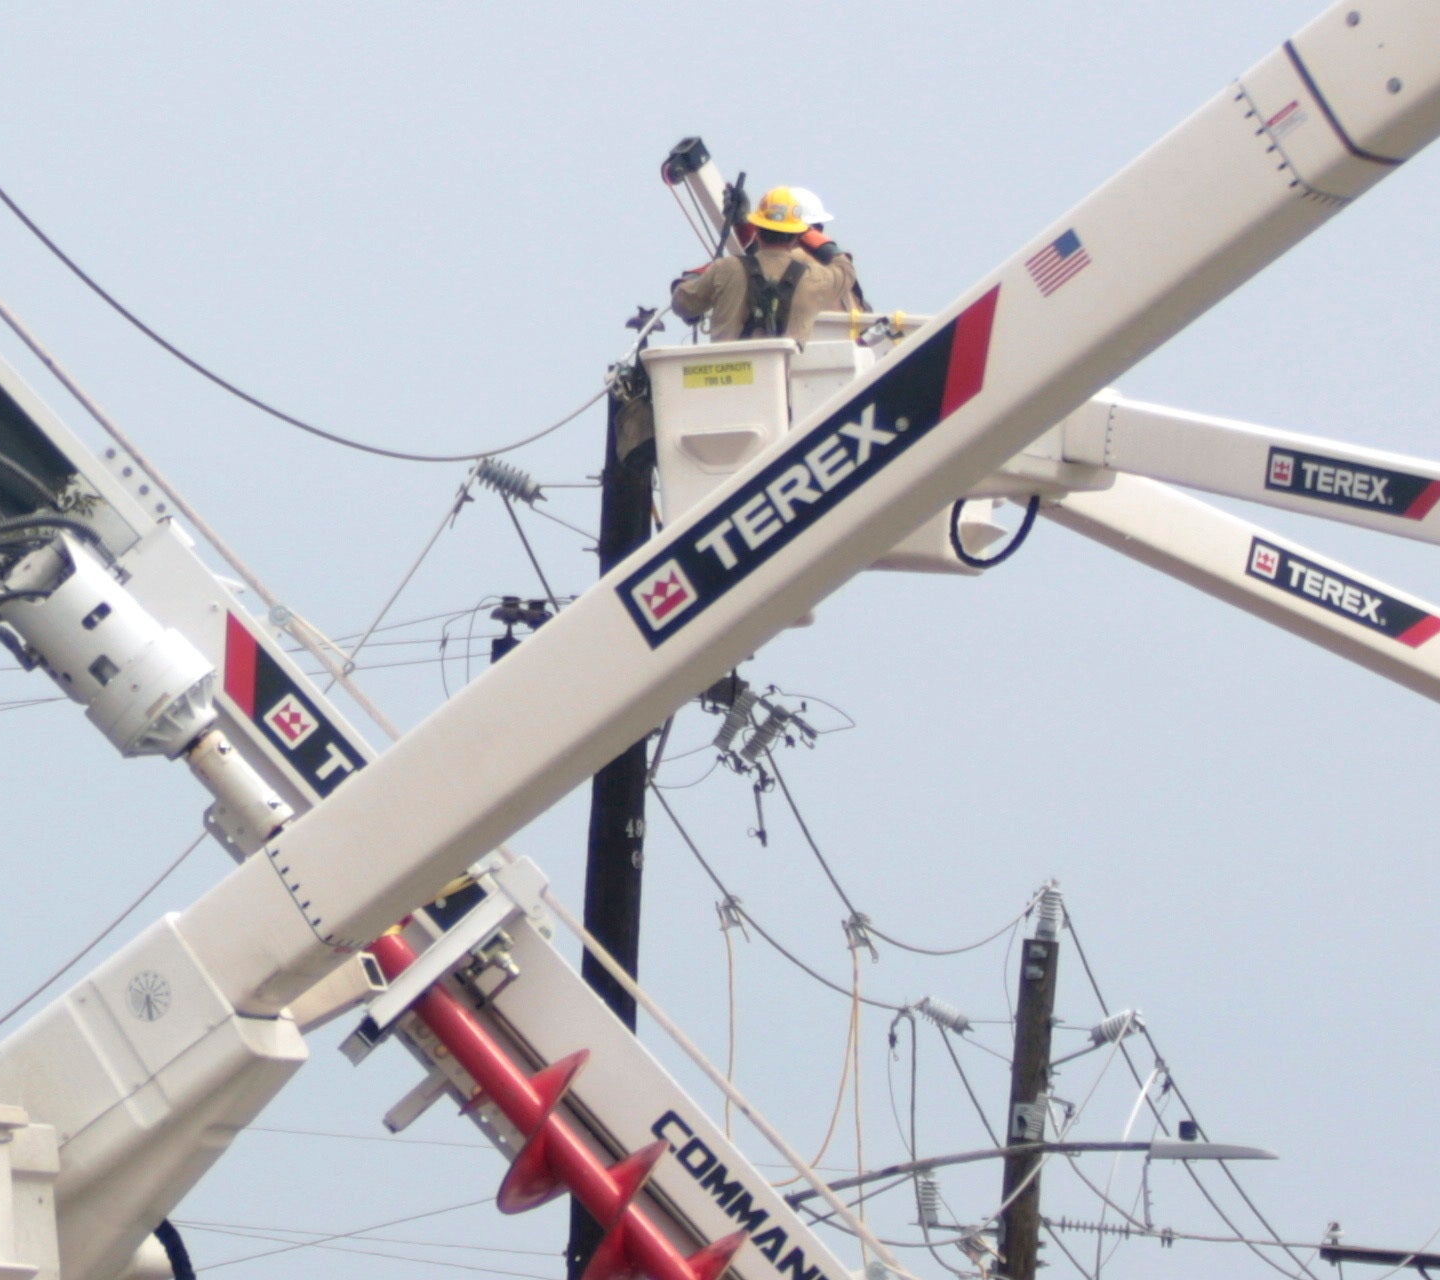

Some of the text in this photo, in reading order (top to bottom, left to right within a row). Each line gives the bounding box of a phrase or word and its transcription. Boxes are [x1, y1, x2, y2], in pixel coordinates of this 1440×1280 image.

[695, 402, 898, 570] TEREX
[1301, 461, 1388, 505] TEREX
[1287, 559, 1382, 625] TEREX
